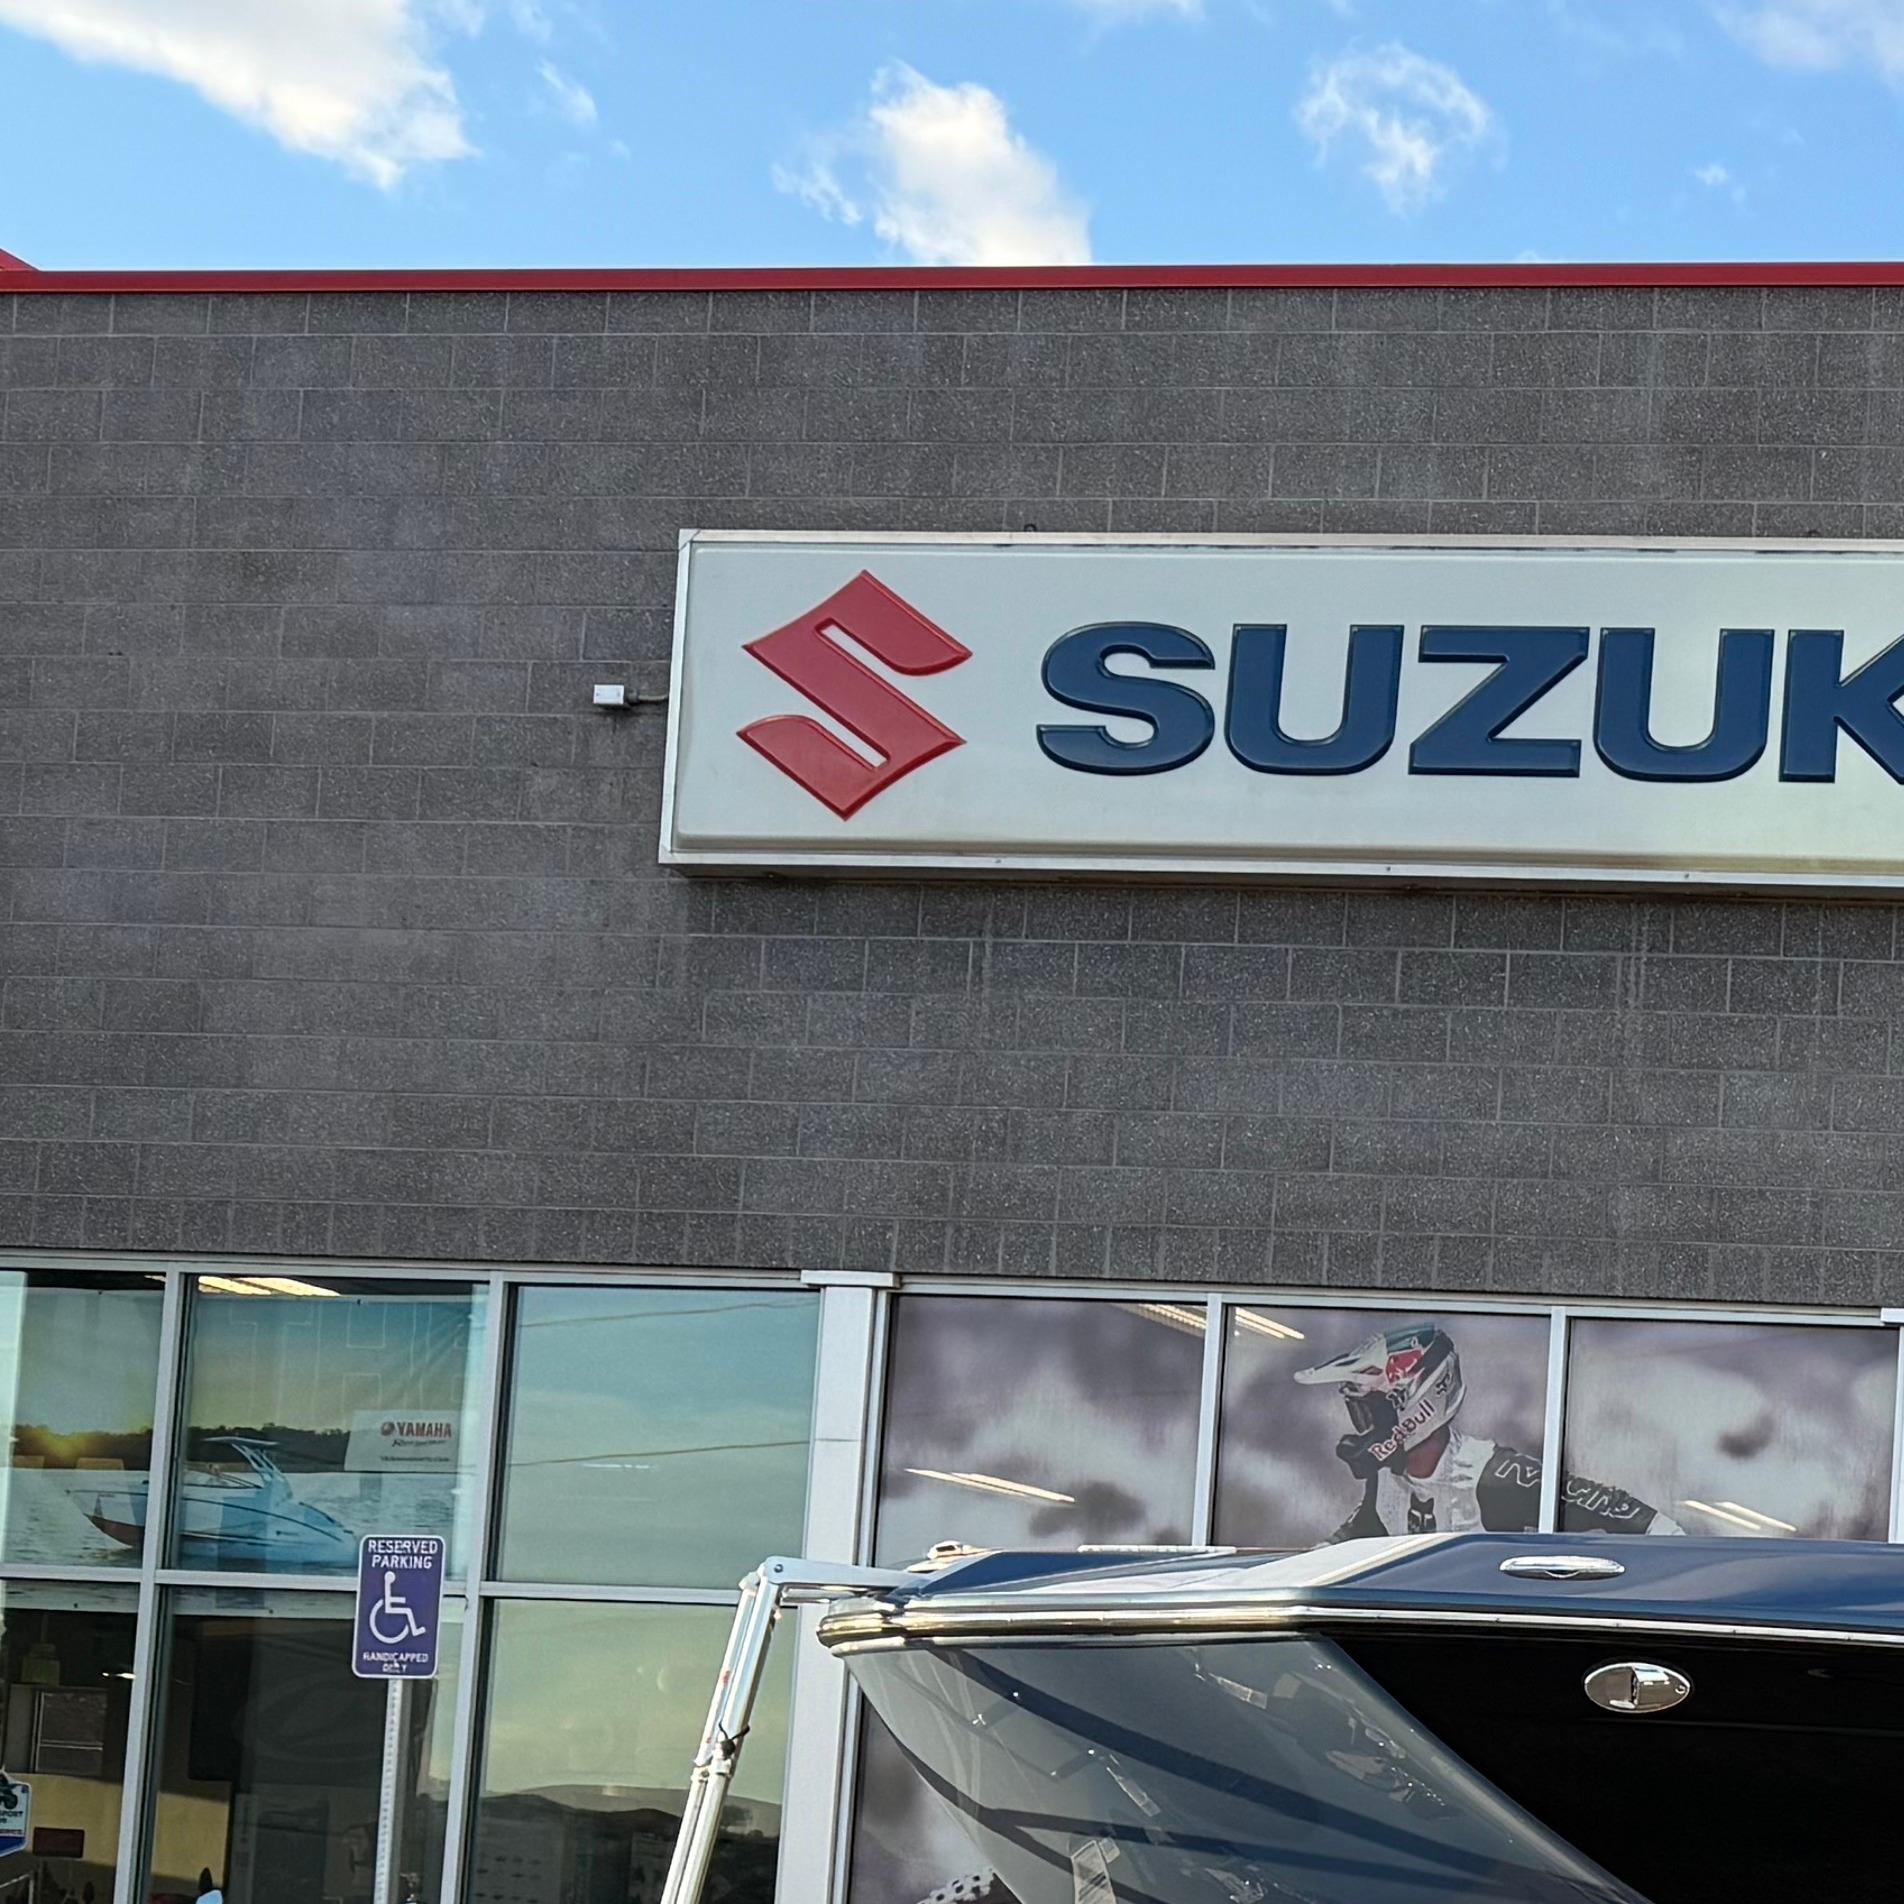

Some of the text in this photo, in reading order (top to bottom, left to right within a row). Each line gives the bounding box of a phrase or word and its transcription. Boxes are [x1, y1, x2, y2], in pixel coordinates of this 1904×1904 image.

[396, 1421, 452, 1438] YAMAHA
[367, 1539, 439, 1555] RESERVED
[371, 1554, 433, 1570] PARKING
